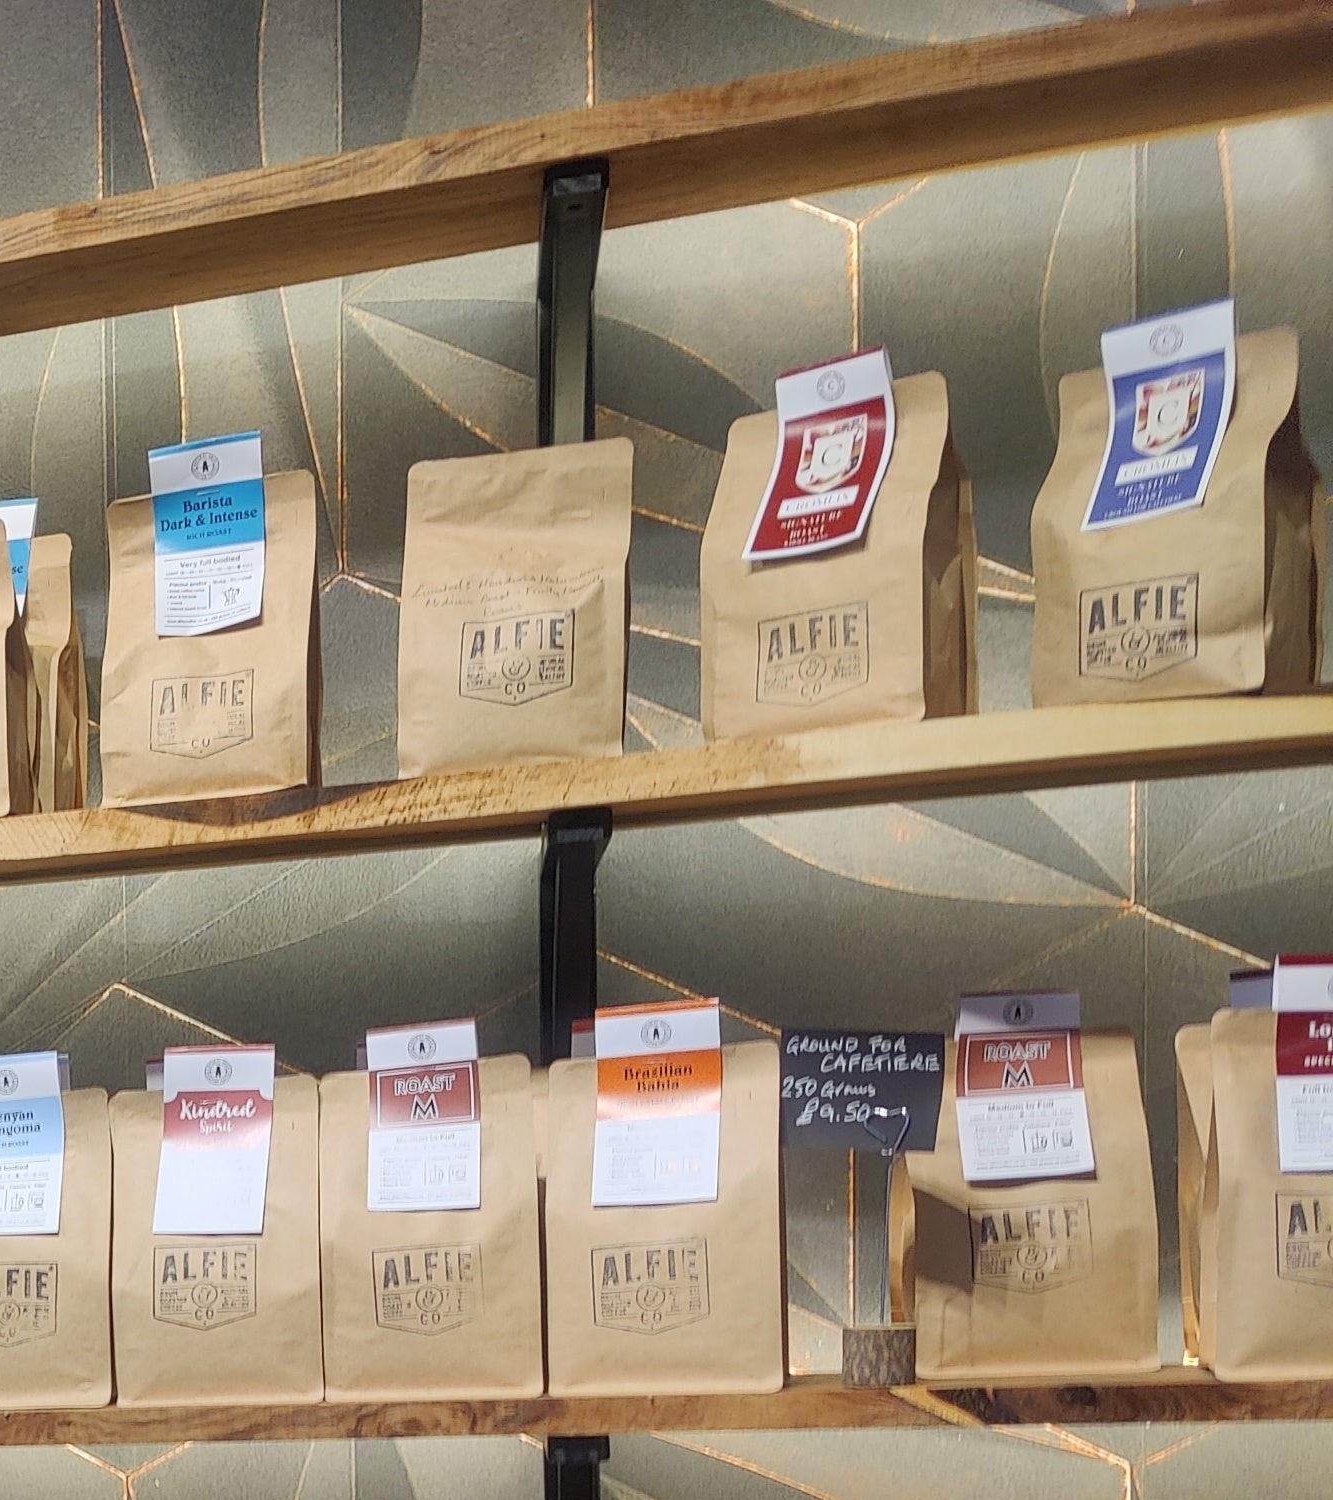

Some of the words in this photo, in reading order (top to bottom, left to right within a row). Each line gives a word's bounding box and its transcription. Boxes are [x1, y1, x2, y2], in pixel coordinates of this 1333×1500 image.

[1156, 402, 1179, 428] C
[820, 443, 843, 468] C
[183, 496, 232, 513] Barista
[161, 517, 191, 532] Dark
[195, 514, 205, 526] &
[210, 509, 258, 524] Intense
[180, 560, 197, 568] Very
[200, 558, 211, 566] full
[213, 555, 241, 564] bodied
[1089, 586, 1187, 634] ALFIE
[470, 618, 565, 659] ALFIE
[768, 613, 858, 663] ALFIE
[159, 679, 245, 716] ALFIE
[505, 682, 526, 695] CO
[786, 1034, 858, 1056] GROUND
[868, 1034, 907, 1054] FOR
[983, 1040, 1051, 1062] ROAST
[624, 1063, 693, 1081] Brazilian
[820, 1053, 940, 1073] CAFETIERE
[1002, 1060, 1034, 1089] M
[394, 1071, 456, 1097] ROAST
[637, 1077, 680, 1093] Bahia
[782, 1075, 817, 1099] 250
[178, 1099, 257, 1121] Kindred
[410, 1094, 439, 1120] M
[795, 1097, 870, 1127] £9.50
[198, 1120, 234, 1135] Spirit
[981, 1208, 1079, 1244] ALFIE
[162, 1249, 249, 1284] ALFIE
[382, 1250, 474, 1289] ALFIE
[601, 1248, 699, 1287] ALFIE
